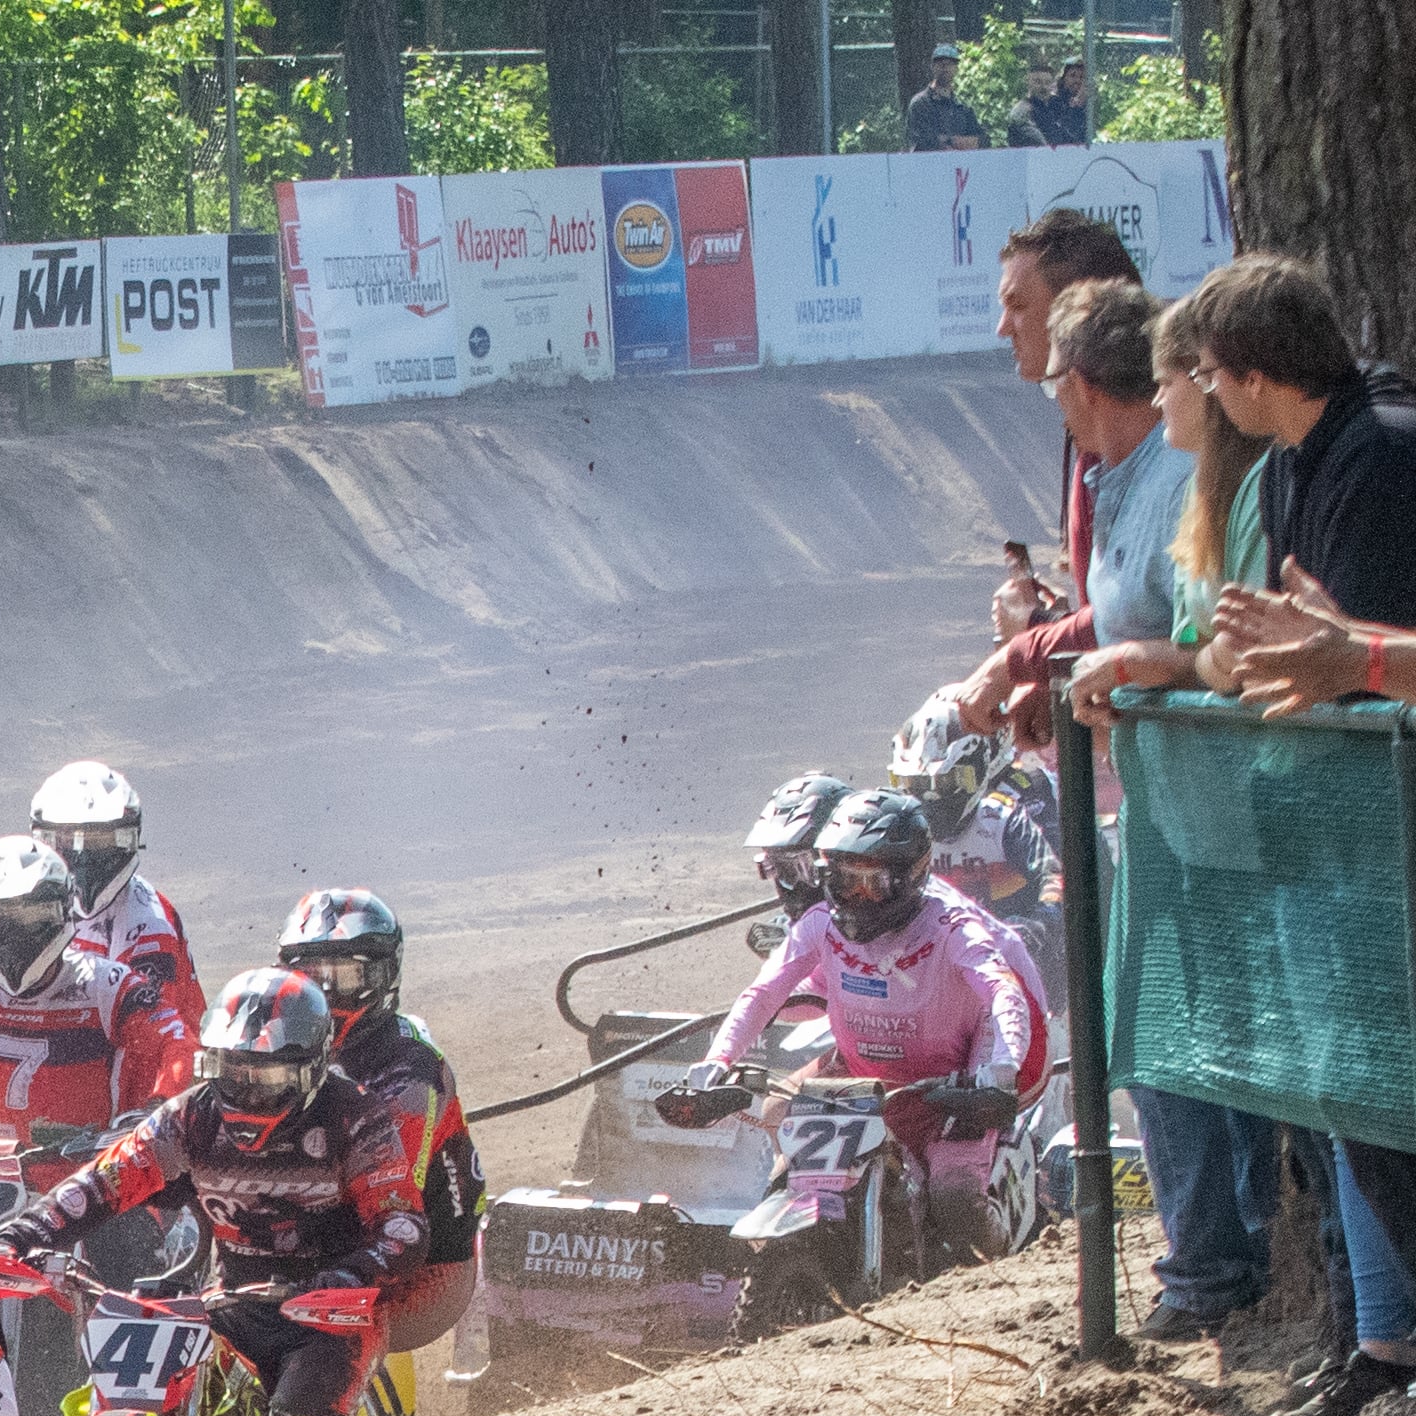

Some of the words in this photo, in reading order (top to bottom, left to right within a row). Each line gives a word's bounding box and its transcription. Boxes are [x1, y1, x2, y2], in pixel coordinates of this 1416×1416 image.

[455, 217, 528, 271] Klaaysen
[549, 208, 597, 257] Auto's
[13, 247, 95, 330] KTM
[123, 277, 221, 333] POST
[792, 1119, 868, 1170] 21
[524, 1261, 585, 1284] EETERIJ
[589, 1260, 604, 1280] &
[526, 1230, 666, 1266] DANNY'S
